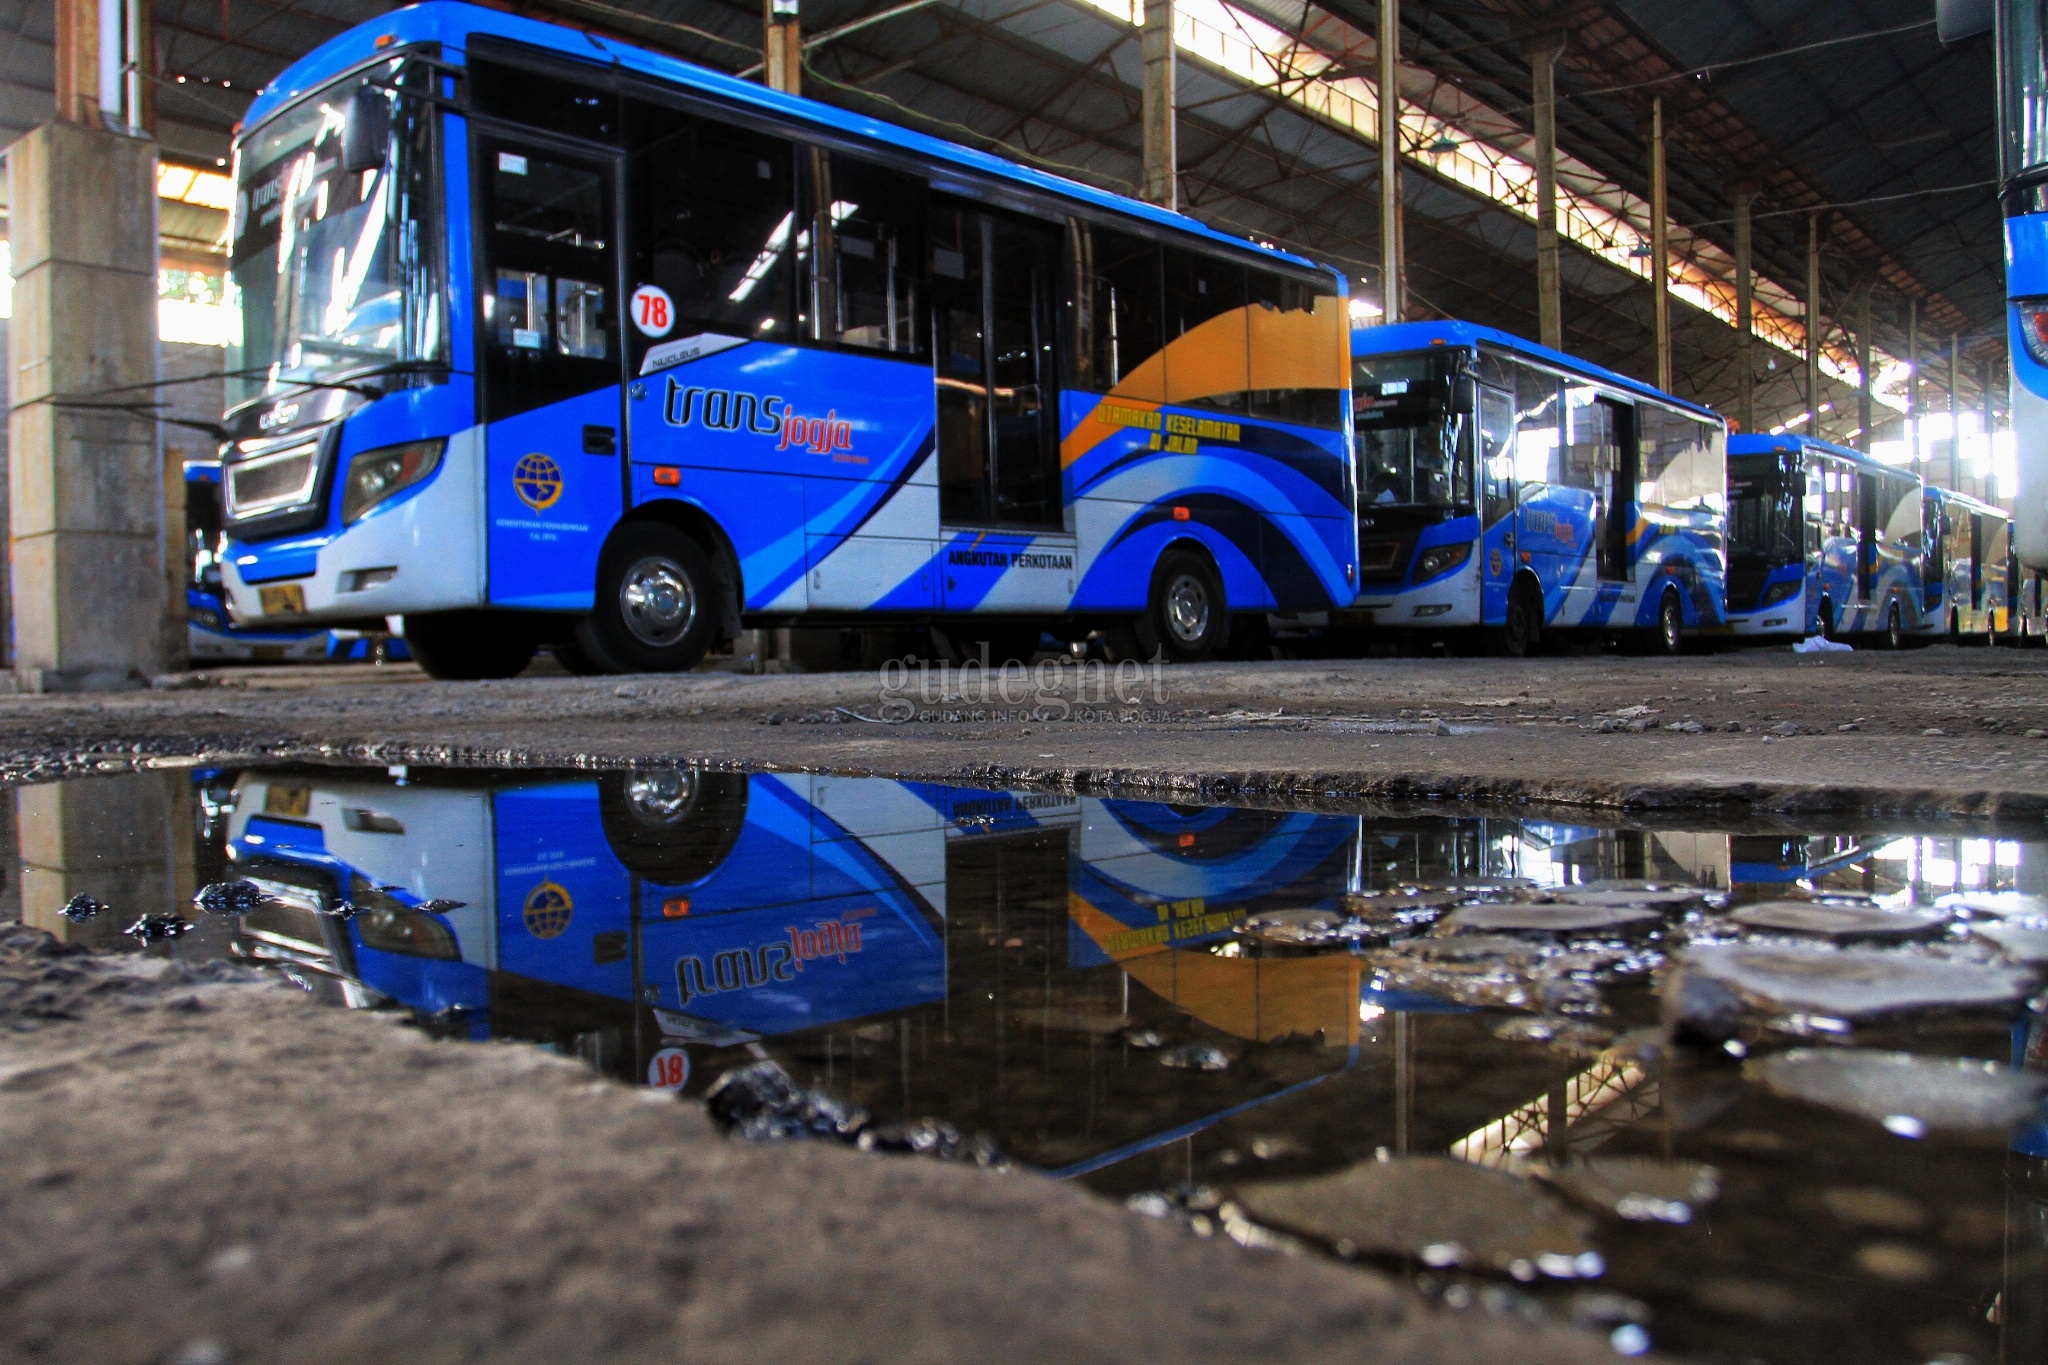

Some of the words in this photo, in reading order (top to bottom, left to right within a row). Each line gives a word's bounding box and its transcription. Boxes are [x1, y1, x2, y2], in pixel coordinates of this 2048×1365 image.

[638, 294, 667, 328] 78
[652, 347, 700, 368] NUCLEUS
[1097, 403, 1162, 430] UTAMAKAN
[1166, 414, 1241, 442] KESELAMATAN
[1150, 433, 1162, 450] DI
[1165, 435, 1198, 455] JALAN
[949, 551, 1008, 567] ANGKUTAN
[1011, 553, 1072, 570] PERKOTAAN
